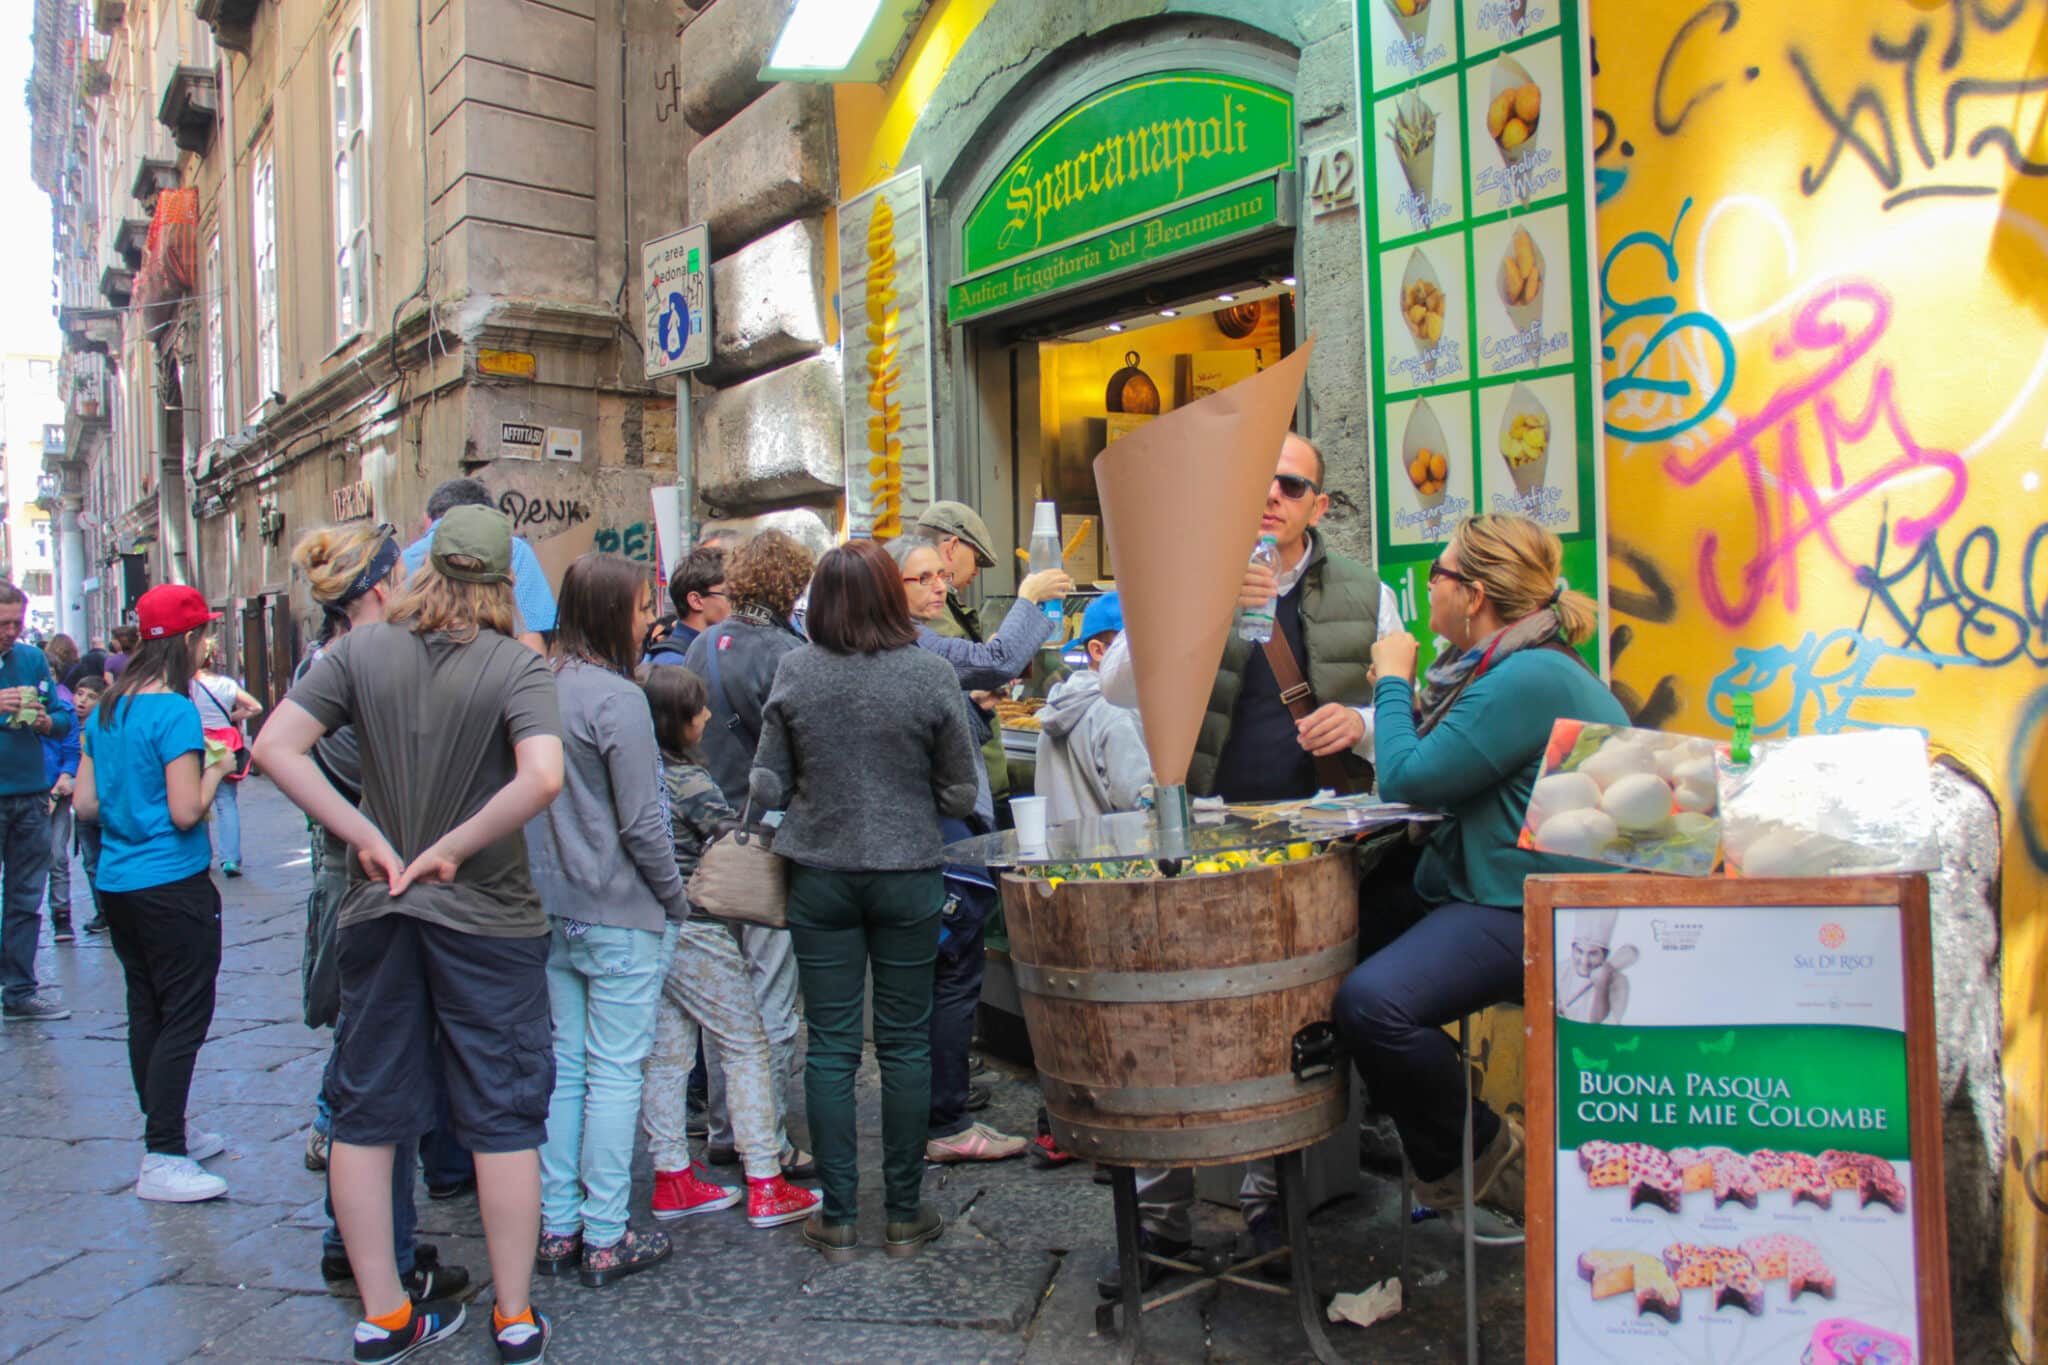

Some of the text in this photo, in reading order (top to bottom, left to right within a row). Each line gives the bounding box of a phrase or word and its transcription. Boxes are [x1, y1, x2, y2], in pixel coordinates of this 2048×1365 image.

[997, 94, 1249, 251] Spaccanapoli
[1311, 149, 1356, 205] 42
[1475, 148, 1552, 195] Zeppoline
[1514, 167, 1562, 200] Mare
[664, 244, 685, 263] area
[956, 195, 1264, 313] Antica friggitoria del Decumano
[503, 426, 542, 444] AFFITTASI
[1579, 1071, 1792, 1102] BUONA PASQUA
[1577, 1101, 1889, 1130] CON LE MIE COLOMBE
